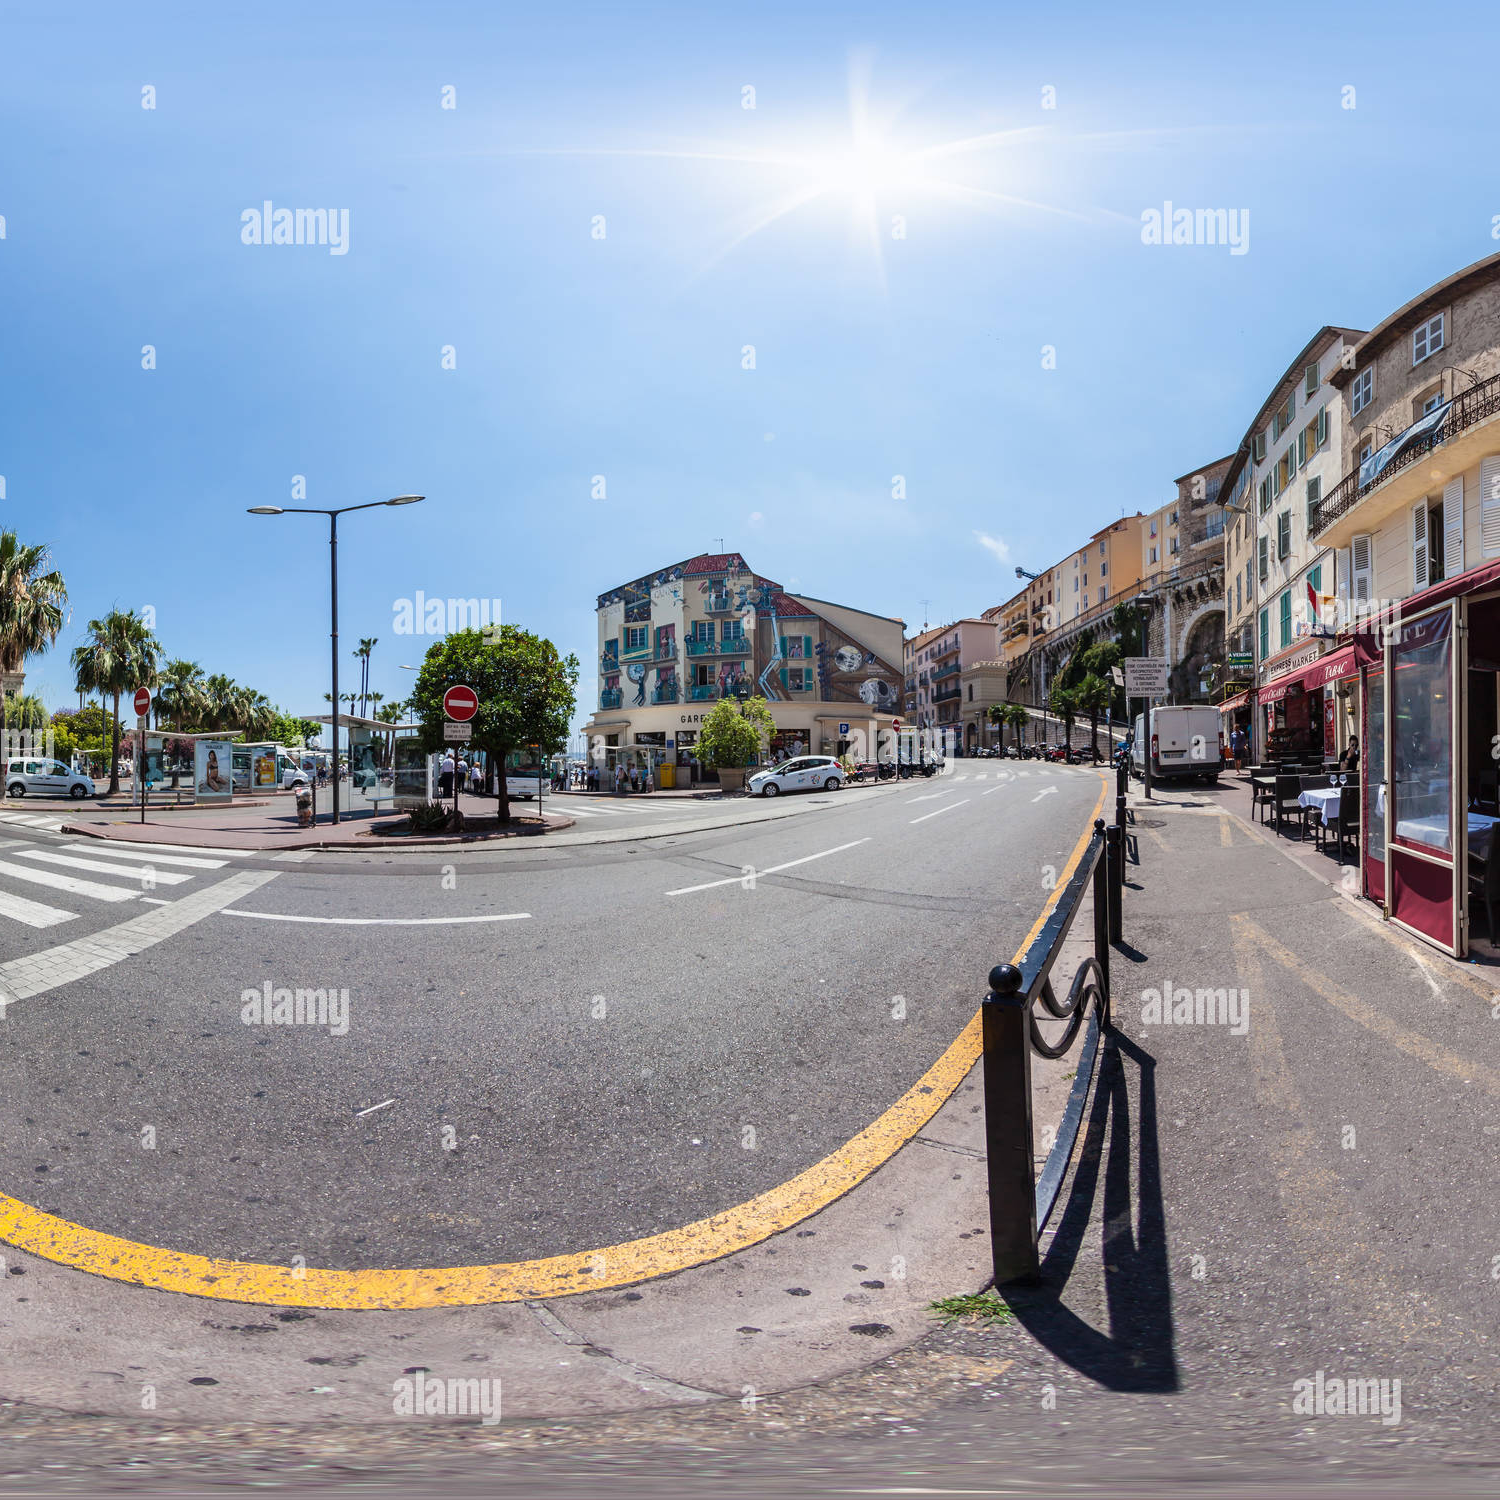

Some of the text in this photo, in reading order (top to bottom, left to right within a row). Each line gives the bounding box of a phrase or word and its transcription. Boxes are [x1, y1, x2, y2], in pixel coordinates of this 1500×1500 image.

[1270, 650, 1318, 674] EXPRESS MARKET
[1324, 662, 1348, 680] TABAC
[680, 714, 705, 724] GARE
